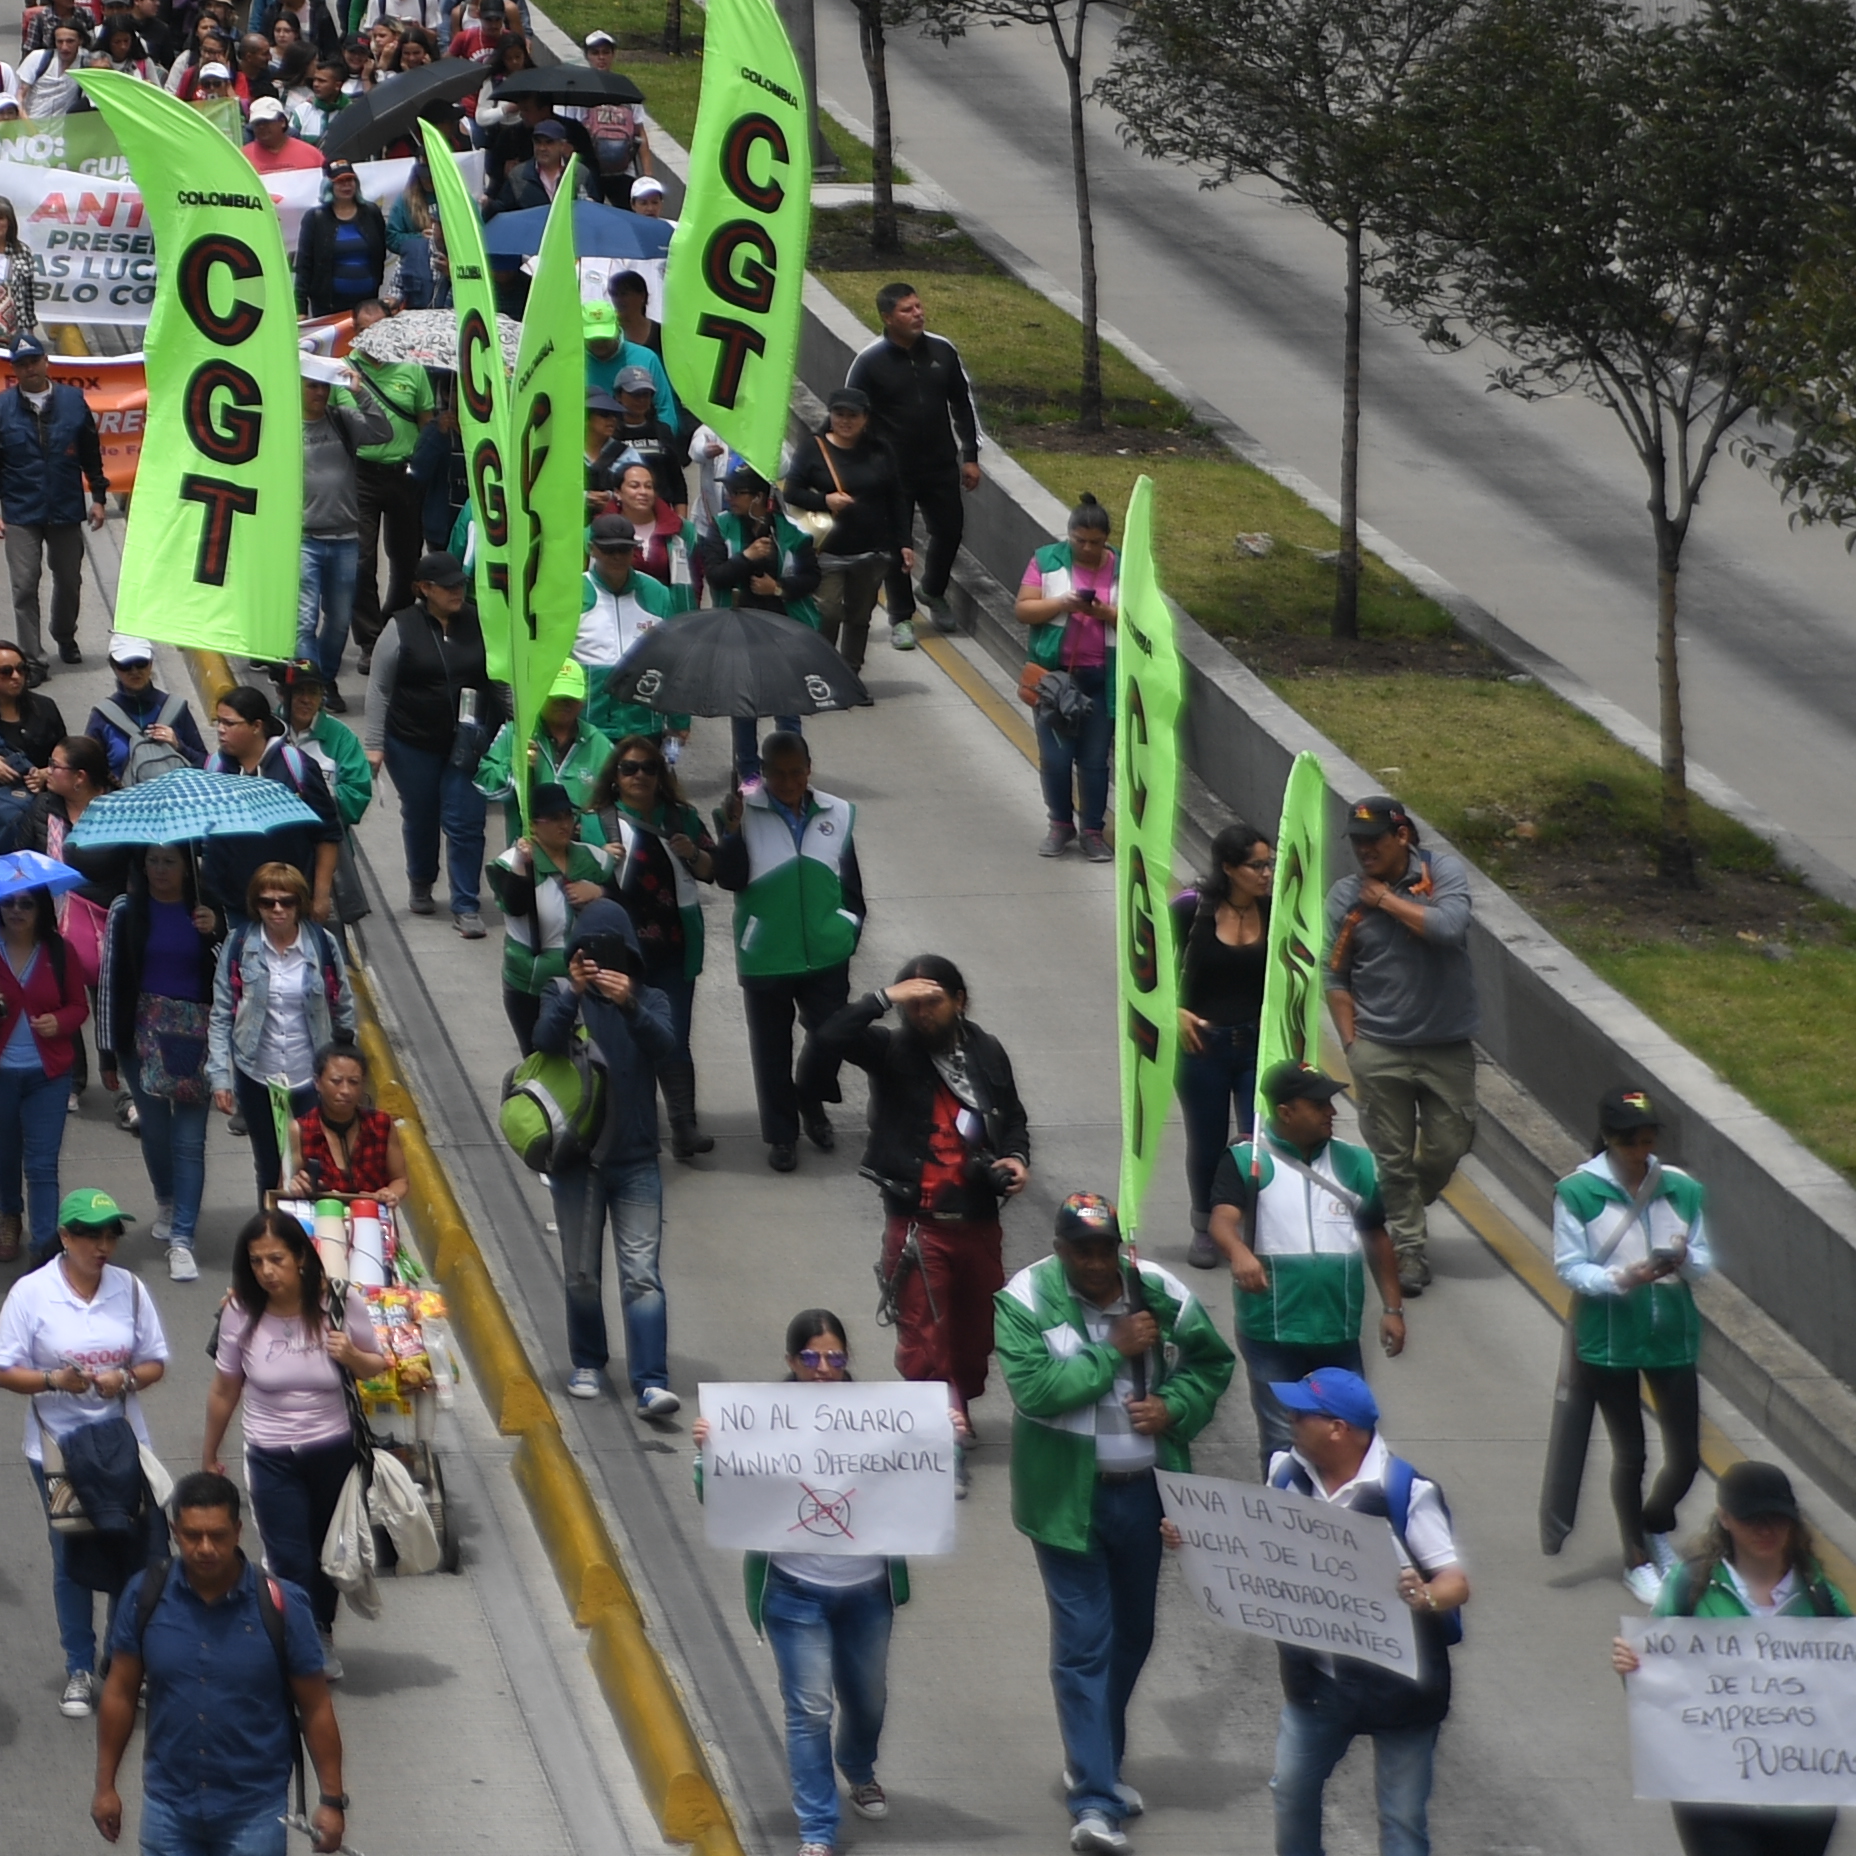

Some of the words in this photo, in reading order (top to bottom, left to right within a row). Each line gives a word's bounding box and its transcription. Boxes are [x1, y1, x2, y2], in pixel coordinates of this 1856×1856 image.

[741, 66, 799, 110] COLOMBIA
[177, 190, 264, 212] COLOMBIA
[696, 112, 790, 410] CGT
[177, 232, 264, 586] CGT
[457, 307, 510, 607] CGT
[1126, 674, 1160, 1158] CGT
[720, 1402, 755, 1432] NO
[770, 1403, 799, 1431] AL
[813, 1402, 915, 1434] SALARIO
[713, 1448, 802, 1477] MINIMO
[813, 1447, 947, 1477] DIFERENCIAL
[1167, 1482, 1227, 1515] VIVA
[1242, 1495, 1273, 1524] LA
[1277, 1504, 1358, 1551] JUSTA
[1175, 1525, 1249, 1559] LUCHA
[1259, 1540, 1298, 1567] DE
[1311, 1552, 1358, 1582] LOS
[1213, 1564, 1387, 1623] TRABAJADORES
[1239, 1602, 1403, 1660] ESTUDIANTES
[1644, 1632, 1676, 1655] NO
[1689, 1634, 1706, 1654] A
[1716, 1635, 1741, 1656] LA
[1705, 1674, 1739, 1695] DE
[1751, 1675, 1806, 1695] LAS
[1681, 1705, 1817, 1732] EMPRESAS
